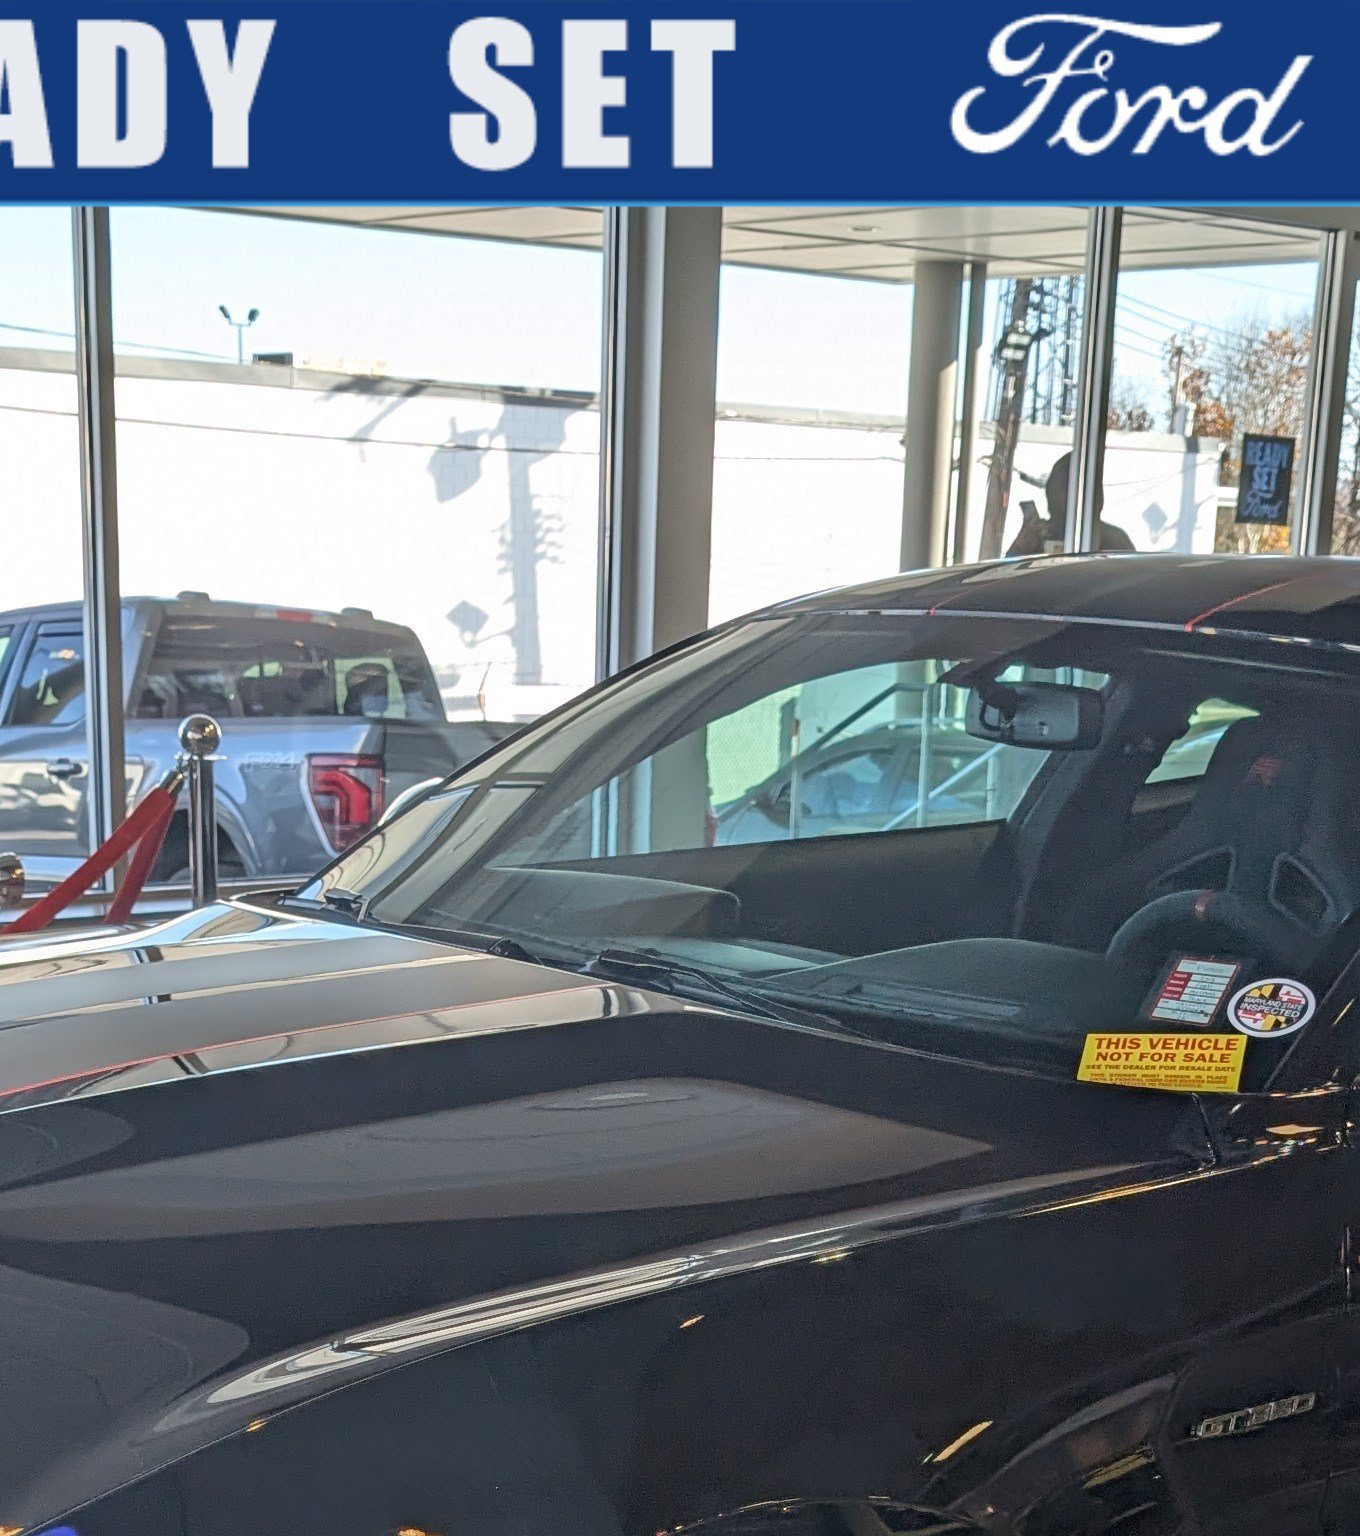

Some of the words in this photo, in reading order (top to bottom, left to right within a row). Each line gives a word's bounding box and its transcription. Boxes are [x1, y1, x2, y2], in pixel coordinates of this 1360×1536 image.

[1240, 1002, 1301, 1018] INSPECTED
[1244, 996, 1281, 1008] MARYLAND
[1281, 1002, 1303, 1011] STATE
[1095, 1038, 1141, 1050] THIS
[1148, 1038, 1239, 1051] VEHICLE
[1096, 1052, 1133, 1061] NOT
[1139, 1052, 1177, 1062] FOR
[1182, 1053, 1231, 1063] SALE
